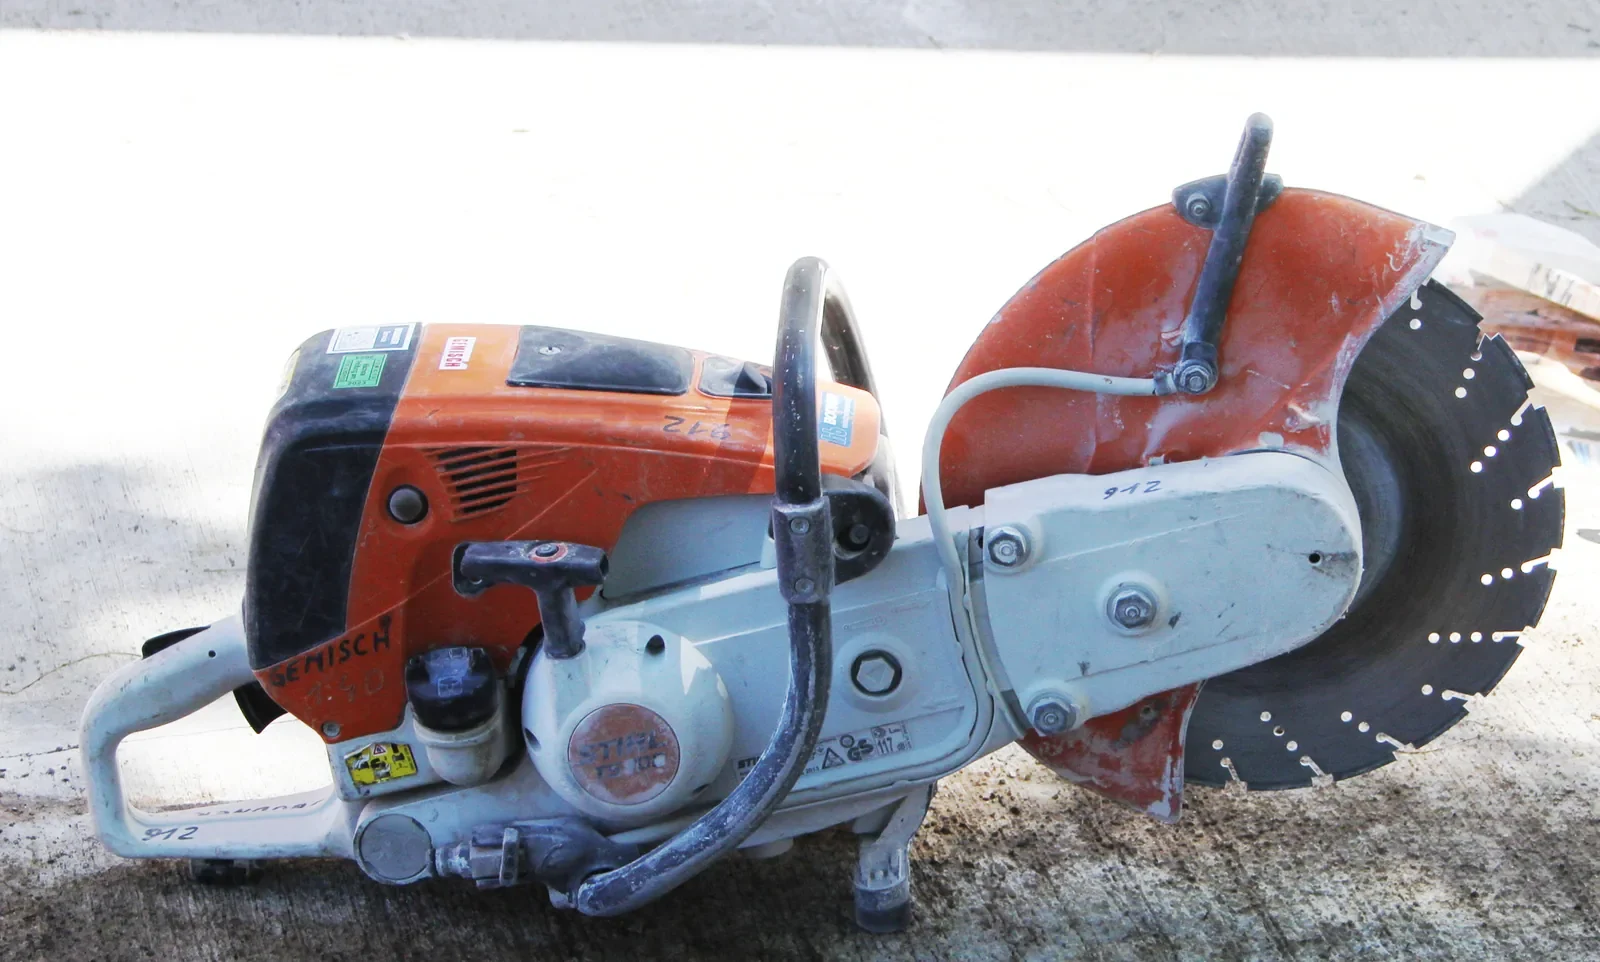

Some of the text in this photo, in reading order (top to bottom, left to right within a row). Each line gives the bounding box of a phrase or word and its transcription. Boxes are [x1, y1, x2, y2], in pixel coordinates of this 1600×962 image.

[444, 338, 469, 367] GEMISCH
[1103, 480, 1162, 500] 912
[269, 629, 391, 688] GEMISCH
[877, 737, 894, 754] 117
[142, 826, 199, 842] 912
